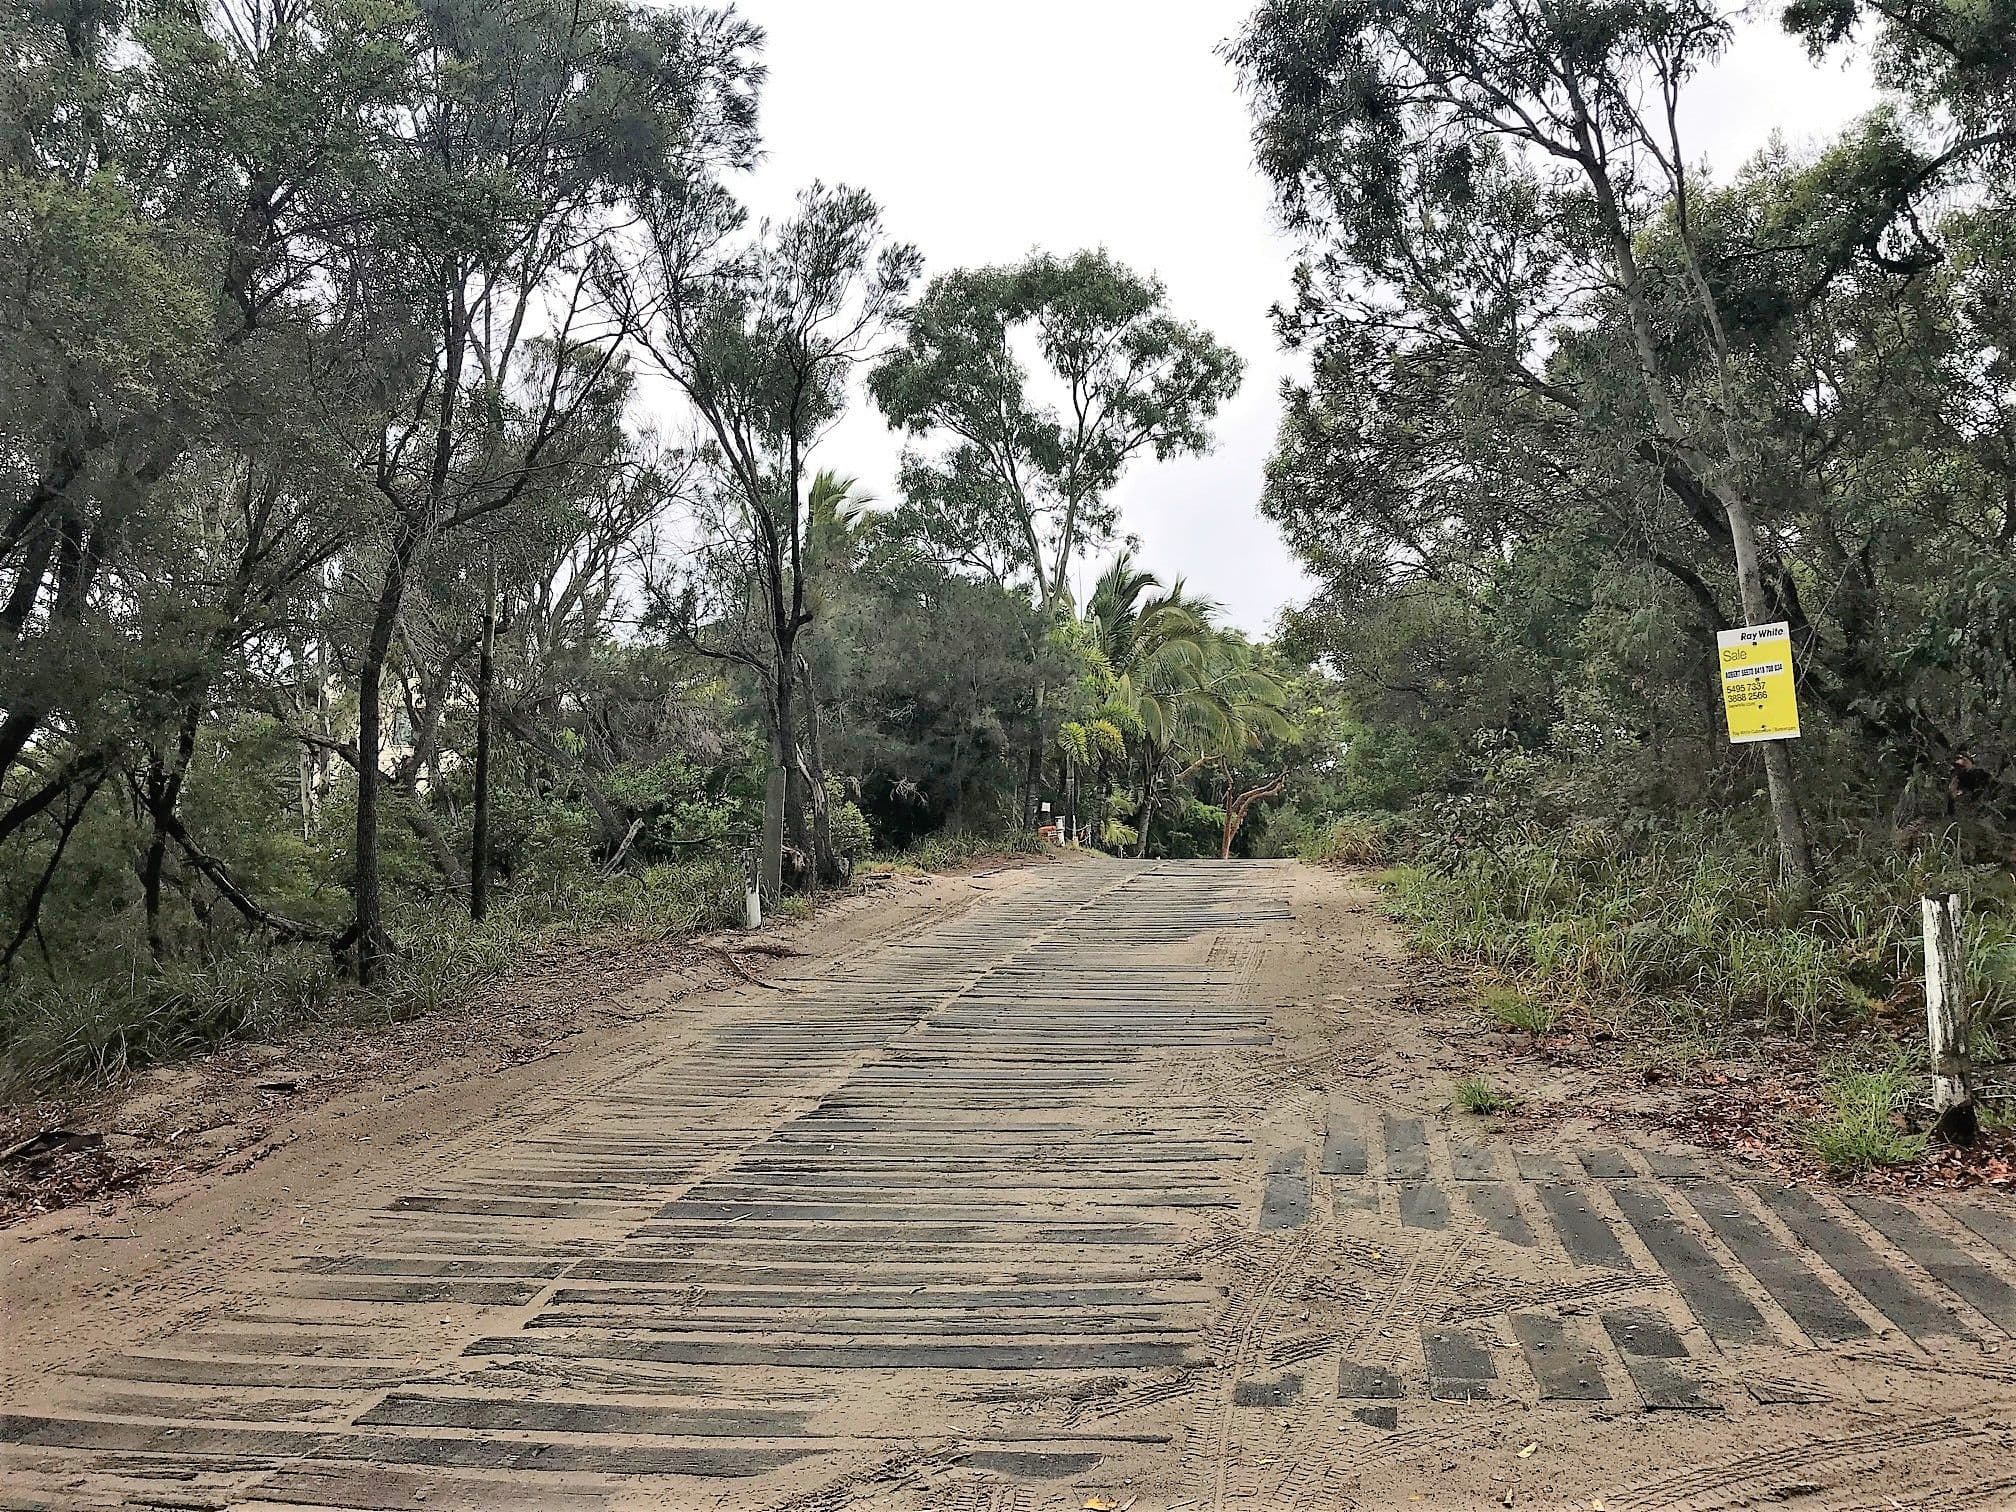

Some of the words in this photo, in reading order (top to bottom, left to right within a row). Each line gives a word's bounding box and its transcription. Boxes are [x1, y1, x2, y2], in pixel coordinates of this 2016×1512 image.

[1740, 632, 1758, 640] Ray
[1759, 628, 1784, 638] White
[1723, 649, 1747, 662] Sale
[1726, 684, 1745, 694] 5495
[1747, 682, 1766, 692] 7337
